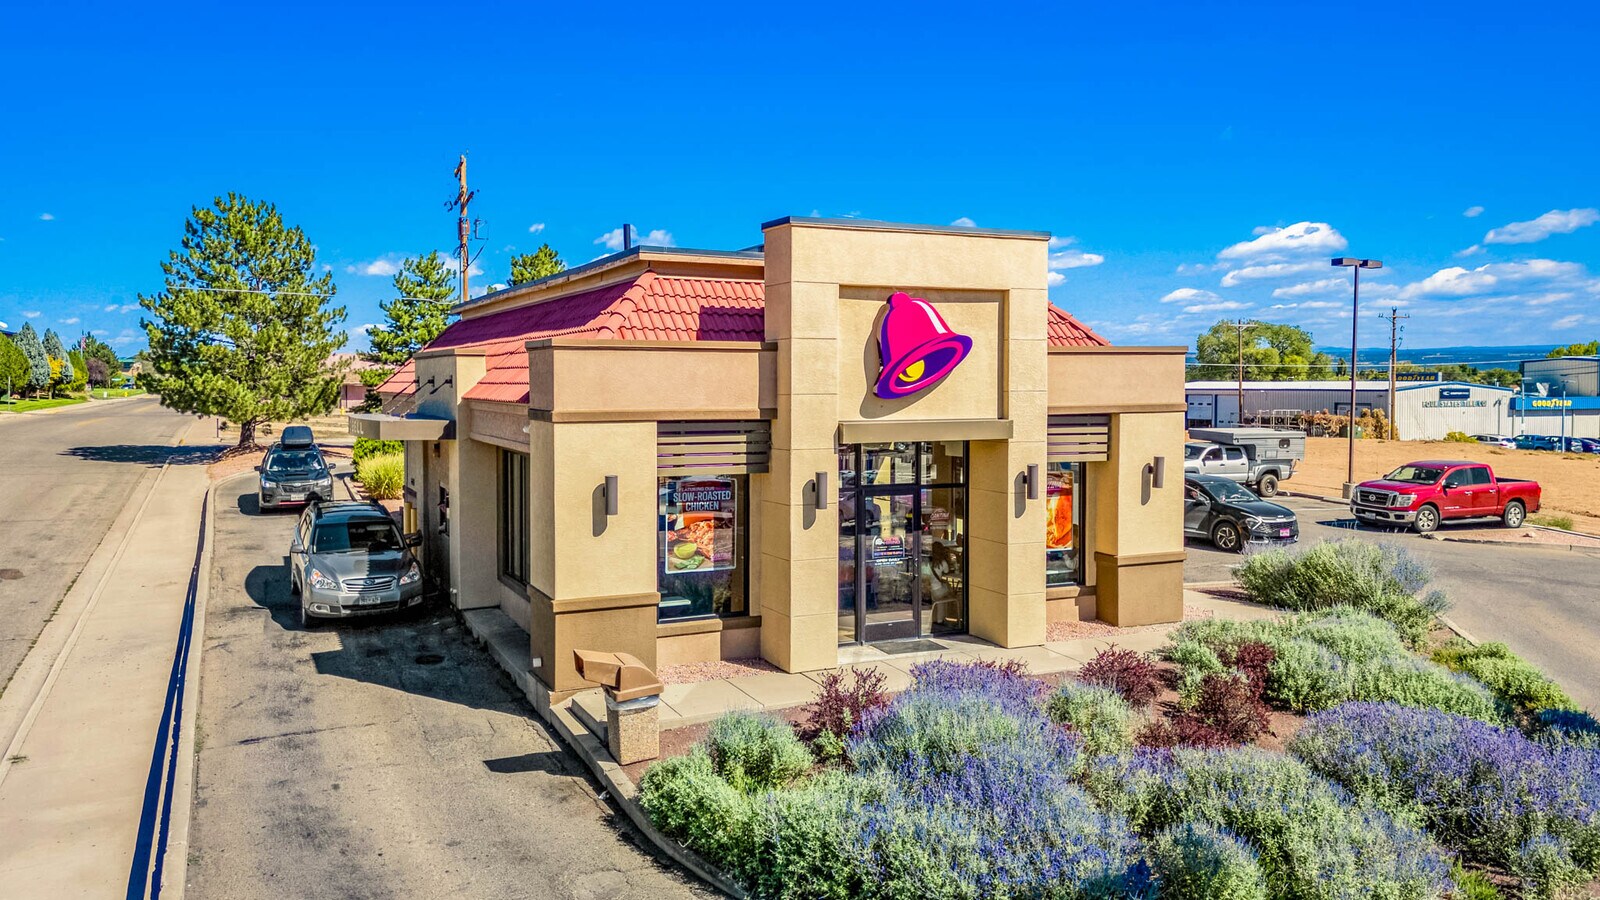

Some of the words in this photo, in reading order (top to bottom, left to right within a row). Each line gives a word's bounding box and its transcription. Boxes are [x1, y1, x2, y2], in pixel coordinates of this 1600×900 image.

[1439, 400, 1460, 408] STATES
[673, 490, 731, 502] SLOW-ROASTED
[685, 501, 719, 511] CHICKEN
